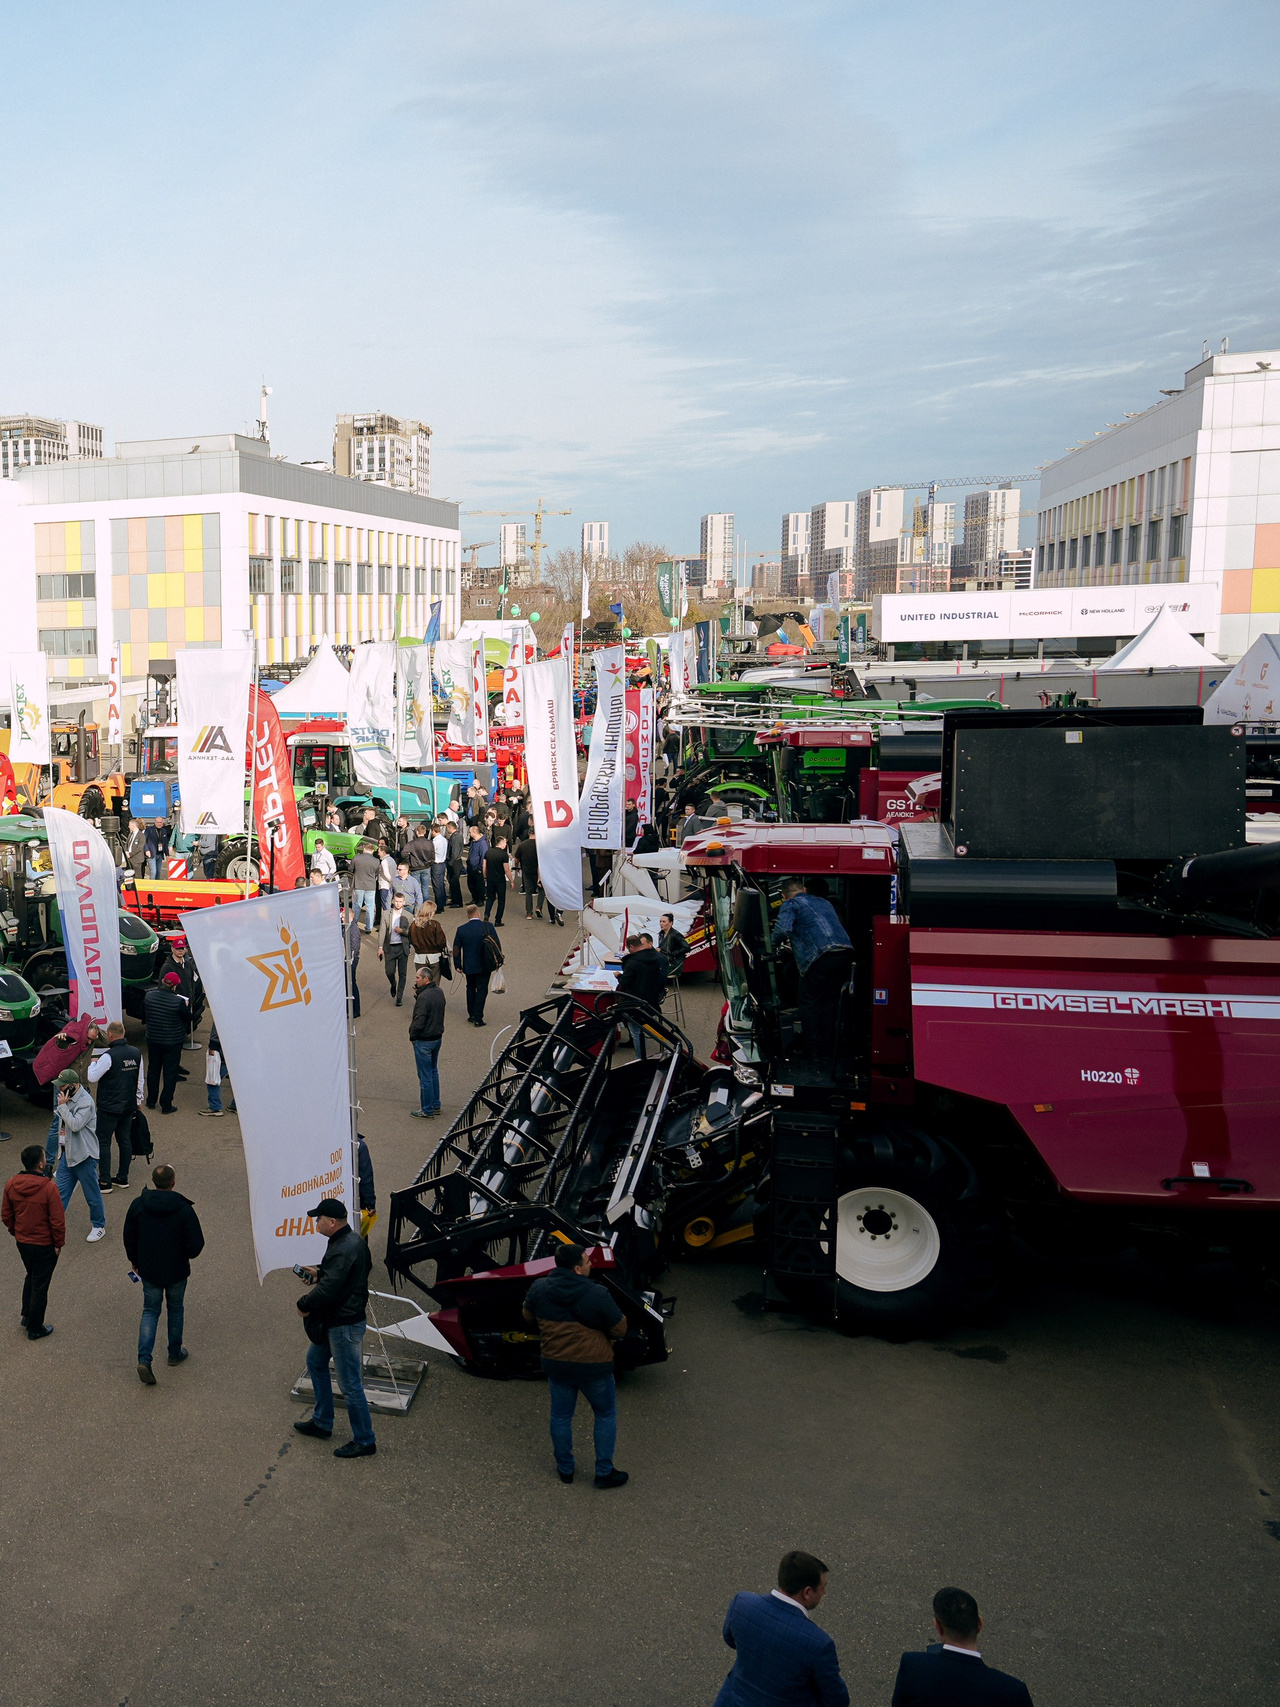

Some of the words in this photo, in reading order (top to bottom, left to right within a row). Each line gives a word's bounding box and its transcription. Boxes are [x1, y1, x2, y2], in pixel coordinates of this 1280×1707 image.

[900, 613, 935, 622] UNITED
[939, 611, 999, 621] INDUSTRIAL
[1144, 605, 1179, 614] CAE
[547, 699, 560, 791] БРЯНСКСЕЛЬМАШ
[996, 993, 1230, 1017] GOMSELMASH
